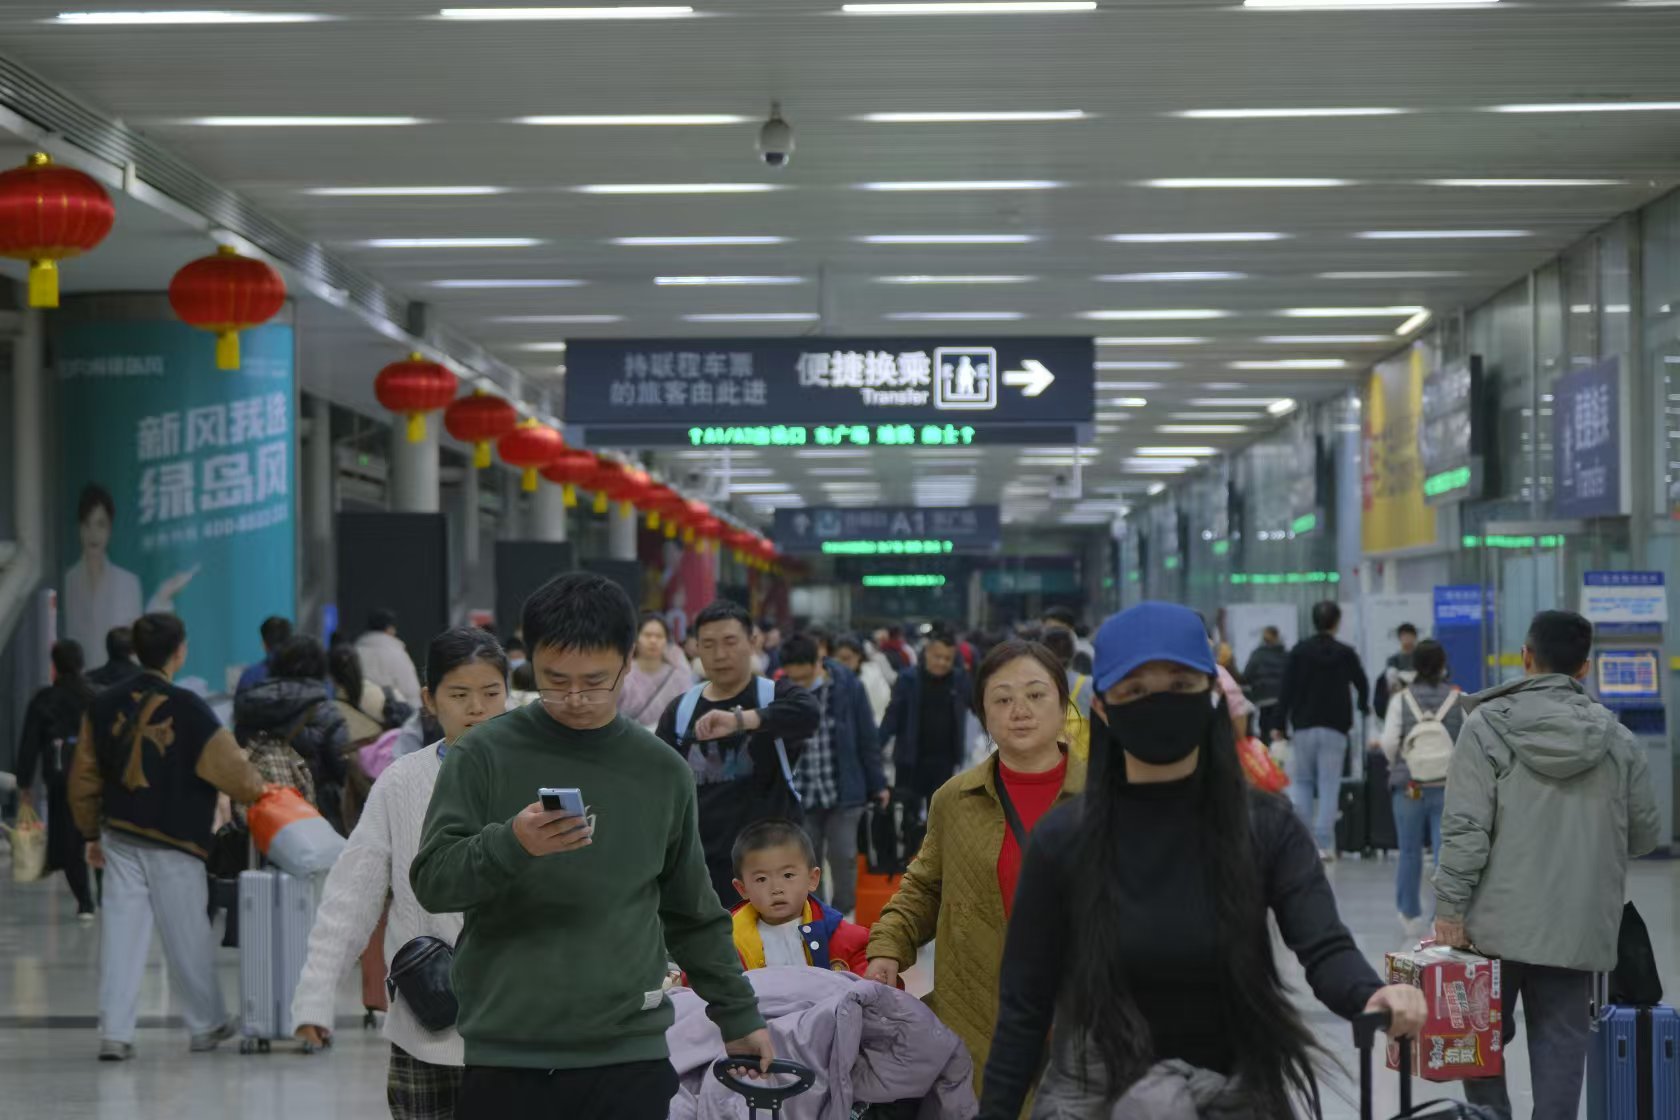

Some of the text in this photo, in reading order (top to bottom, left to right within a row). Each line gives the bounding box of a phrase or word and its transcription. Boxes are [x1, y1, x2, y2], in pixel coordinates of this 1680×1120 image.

[624, 351, 754, 378] 持联程车票
[796, 350, 931, 387] 便捷换乘
[609, 378, 768, 406] 的旅客由此进
[860, 388, 931, 406] Transfer
[137, 390, 286, 461] 新风我选
[139, 441, 287, 526] 绿岛风
